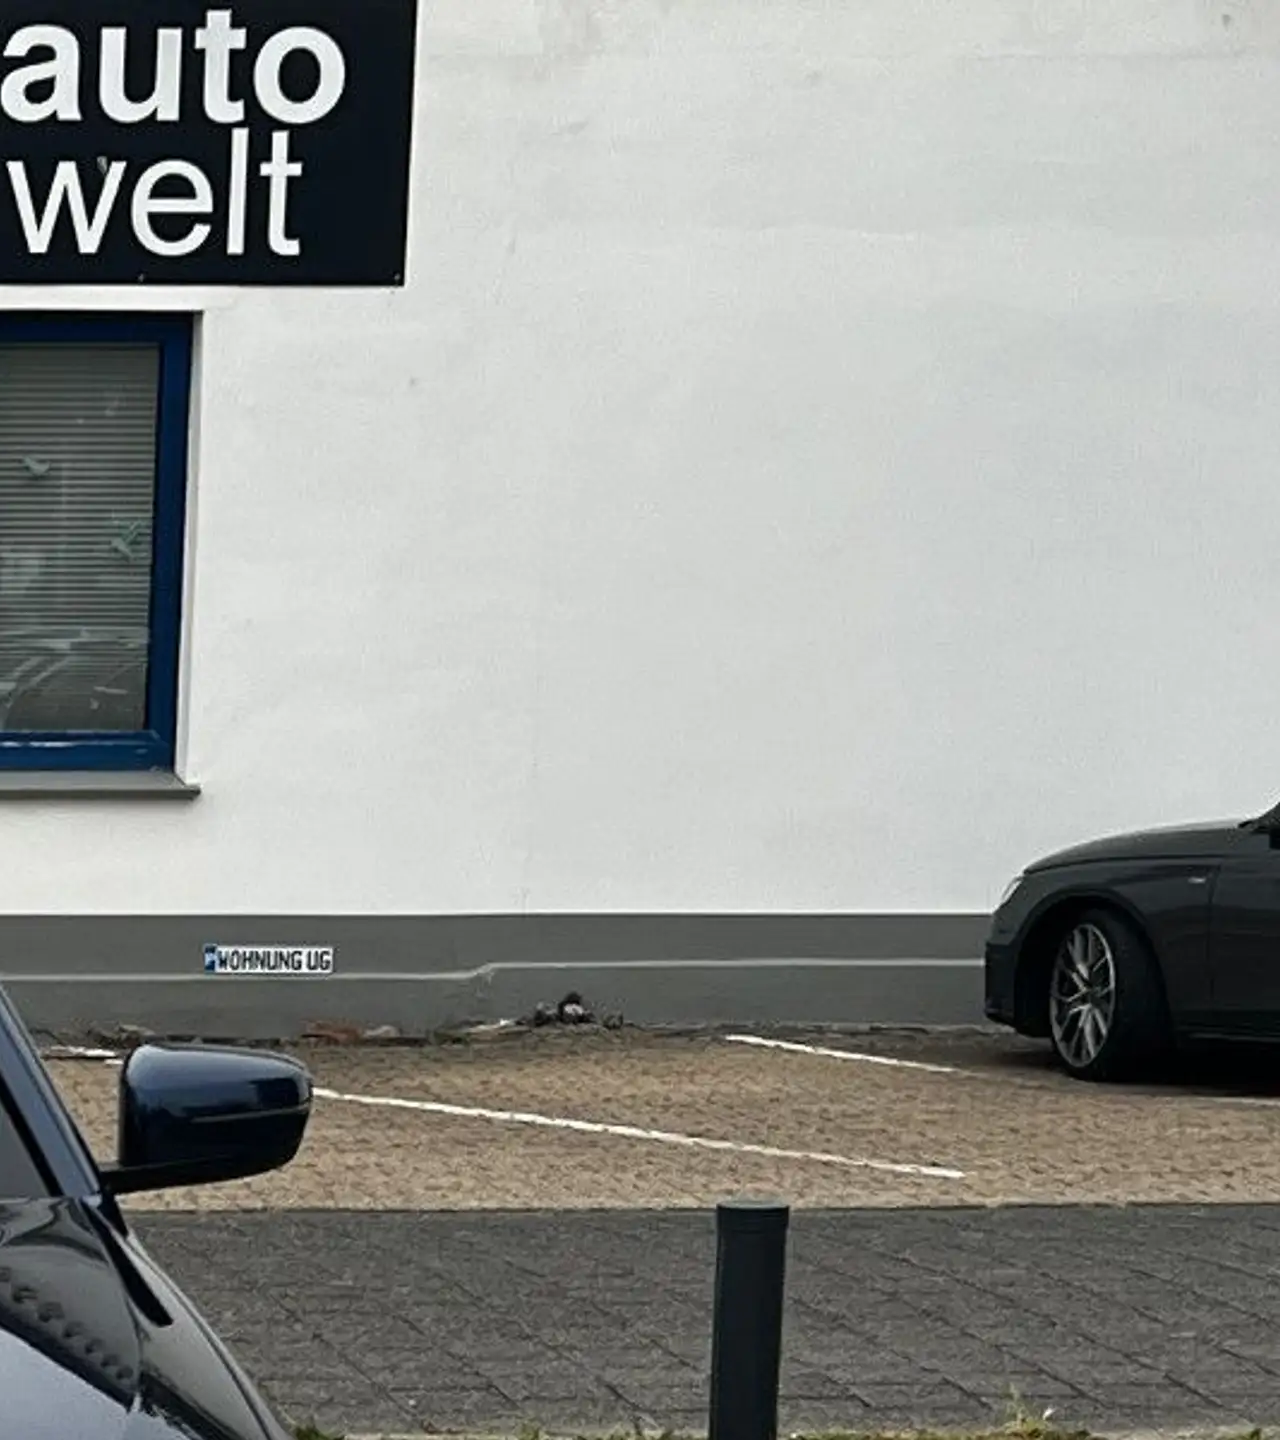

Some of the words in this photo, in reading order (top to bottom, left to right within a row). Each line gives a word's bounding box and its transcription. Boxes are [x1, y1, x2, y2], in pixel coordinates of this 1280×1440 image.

[0, 9, 346, 124] auto
[6, 128, 302, 256] welt
[217, 950, 303, 971] WOHNUNG
